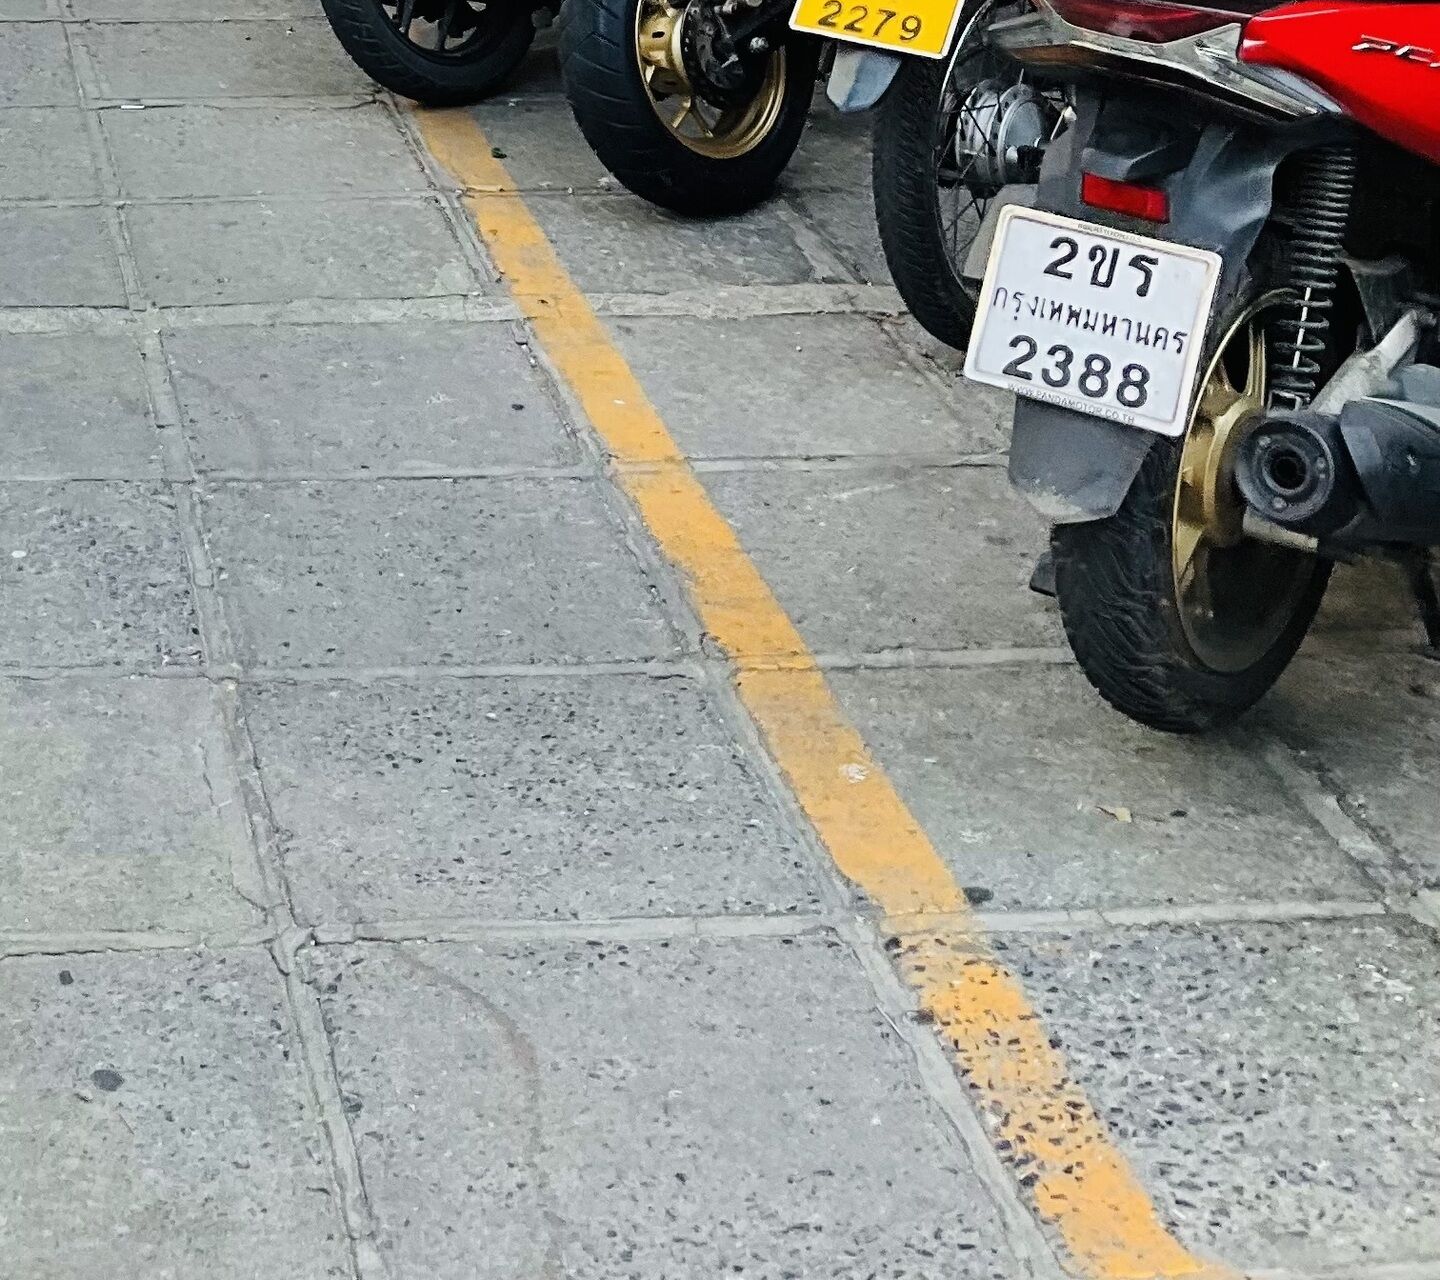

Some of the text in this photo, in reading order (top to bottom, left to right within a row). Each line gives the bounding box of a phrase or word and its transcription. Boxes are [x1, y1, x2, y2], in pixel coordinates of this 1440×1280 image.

[817, 0, 924, 45] 2279
[1043, 236, 1159, 298] 2ขร
[993, 286, 1189, 355] กรุงเทพมหานคร
[1002, 334, 1151, 409] 2388
